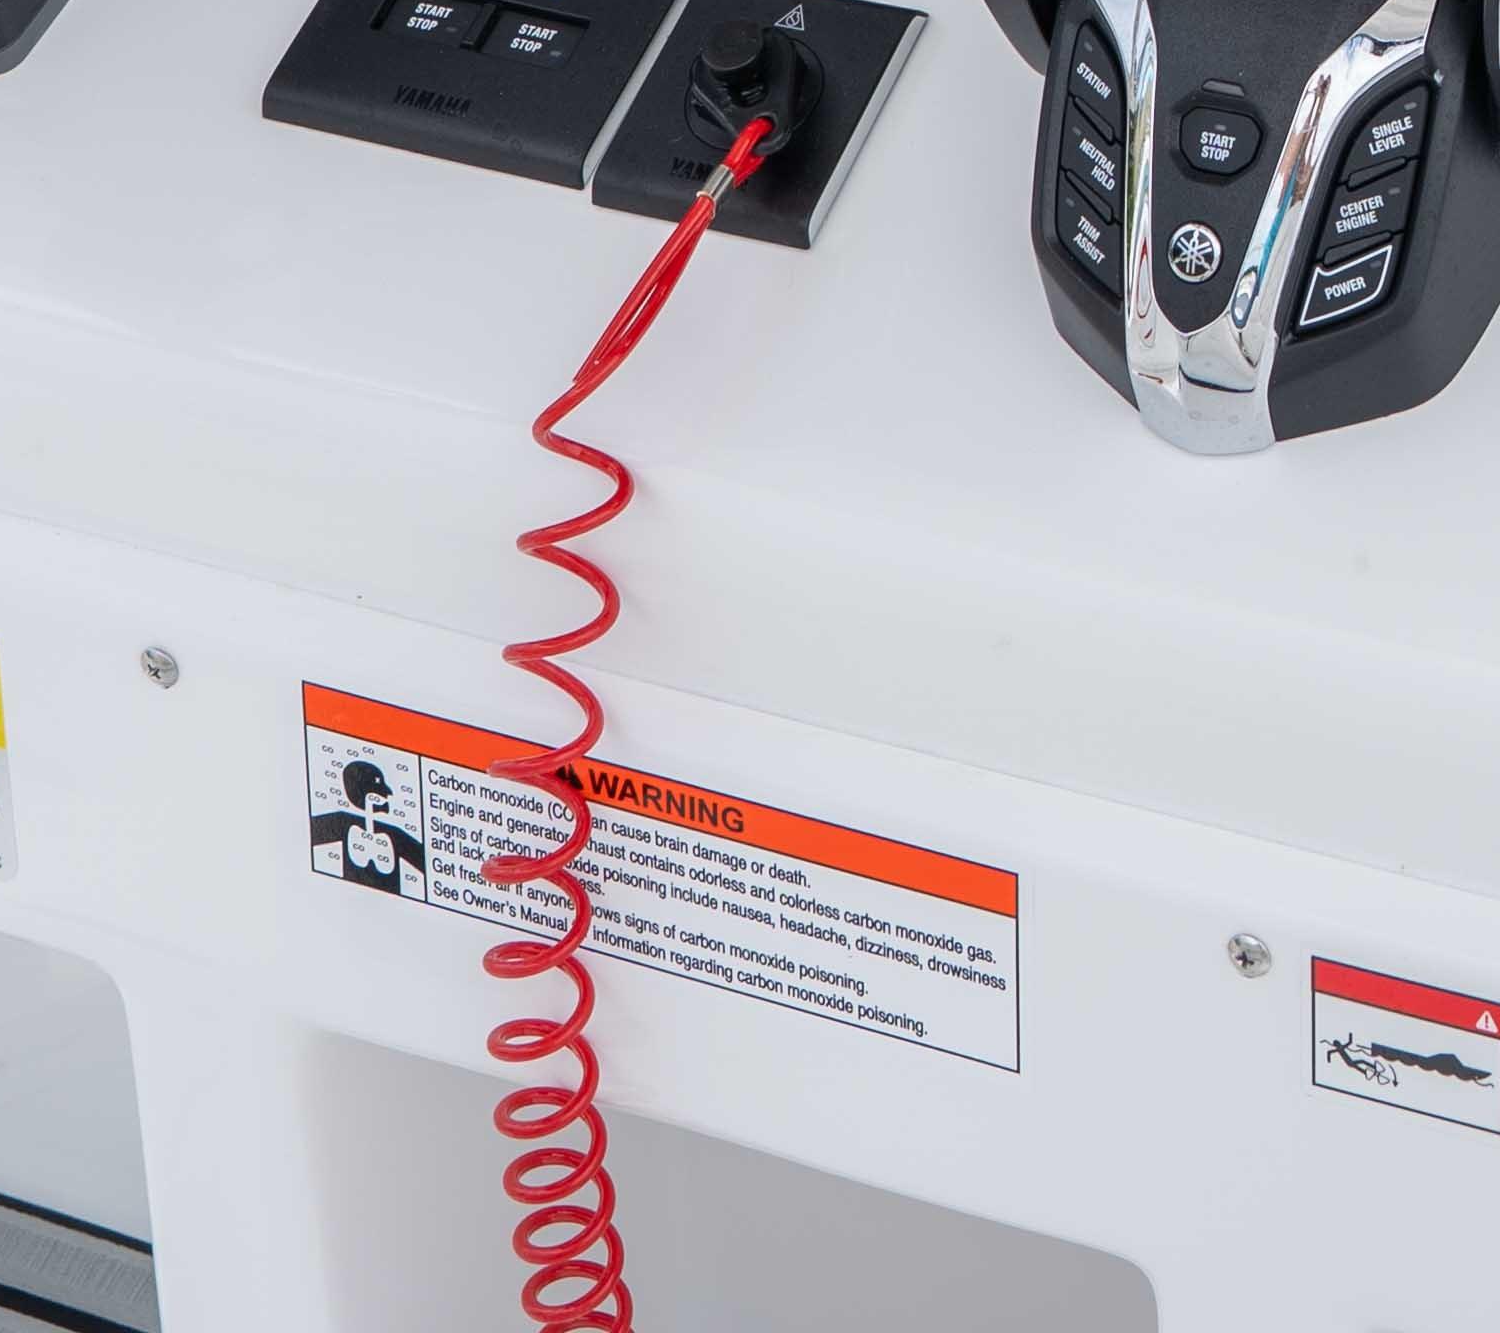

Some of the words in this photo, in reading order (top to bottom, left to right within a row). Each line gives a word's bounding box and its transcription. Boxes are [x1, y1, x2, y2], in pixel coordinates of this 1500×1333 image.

[415, 2, 453, 19] START
[406, 16, 438, 31] STOP
[518, 23, 558, 41] START
[510, 37, 542, 54] STOP
[1076, 62, 1112, 100] STATION
[394, 84, 473, 117] YAMAHA
[1200, 131, 1236, 149] START
[1371, 116, 1414, 140] SINGLE
[1200, 146, 1230, 162] STOP
[1368, 134, 1405, 156] LEVER
[1079, 138, 1117, 177] NEUTRAL
[1091, 164, 1116, 192] HOLD
[1339, 195, 1385, 219] CENTER
[1076, 216, 1101, 243] TRIM
[1335, 211, 1379, 234] ENGINE
[1073, 232, 1106, 265] ASSIST
[1324, 276, 1367, 301] POWER
[588, 767, 745, 834] WARNING
[427, 770, 476, 798] Carbon
[480, 784, 543, 815] monoxide
[611, 823, 652, 843] cause
[654, 828, 689, 854] brain
[692, 839, 747, 872] damage
[750, 859, 765, 875] or
[768, 859, 811, 889] death.
